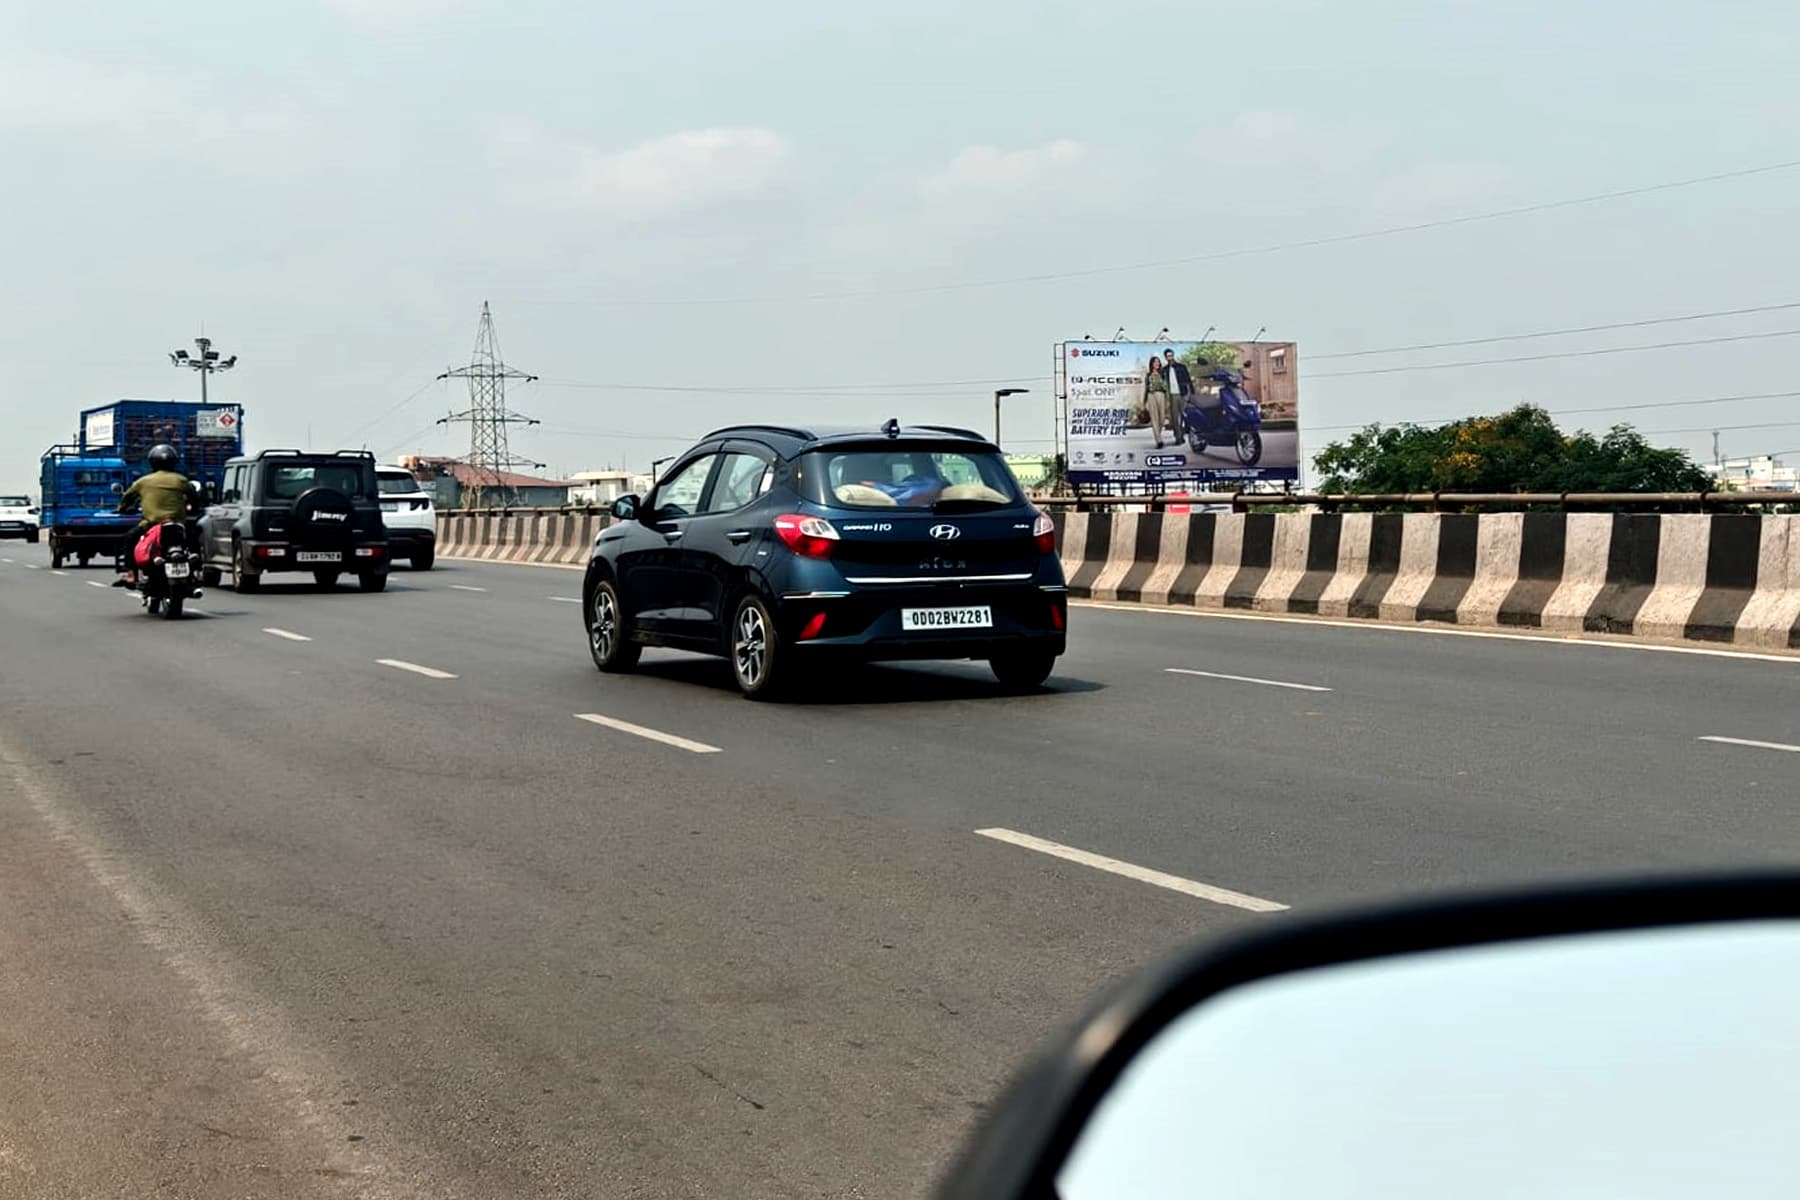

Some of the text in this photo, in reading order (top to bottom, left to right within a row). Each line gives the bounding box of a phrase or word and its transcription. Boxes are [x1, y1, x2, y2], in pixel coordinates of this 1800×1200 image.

[1072, 408, 1130, 418] SUPERIOR RIDE
[1071, 426, 1127, 436] BATTERY LIFE
